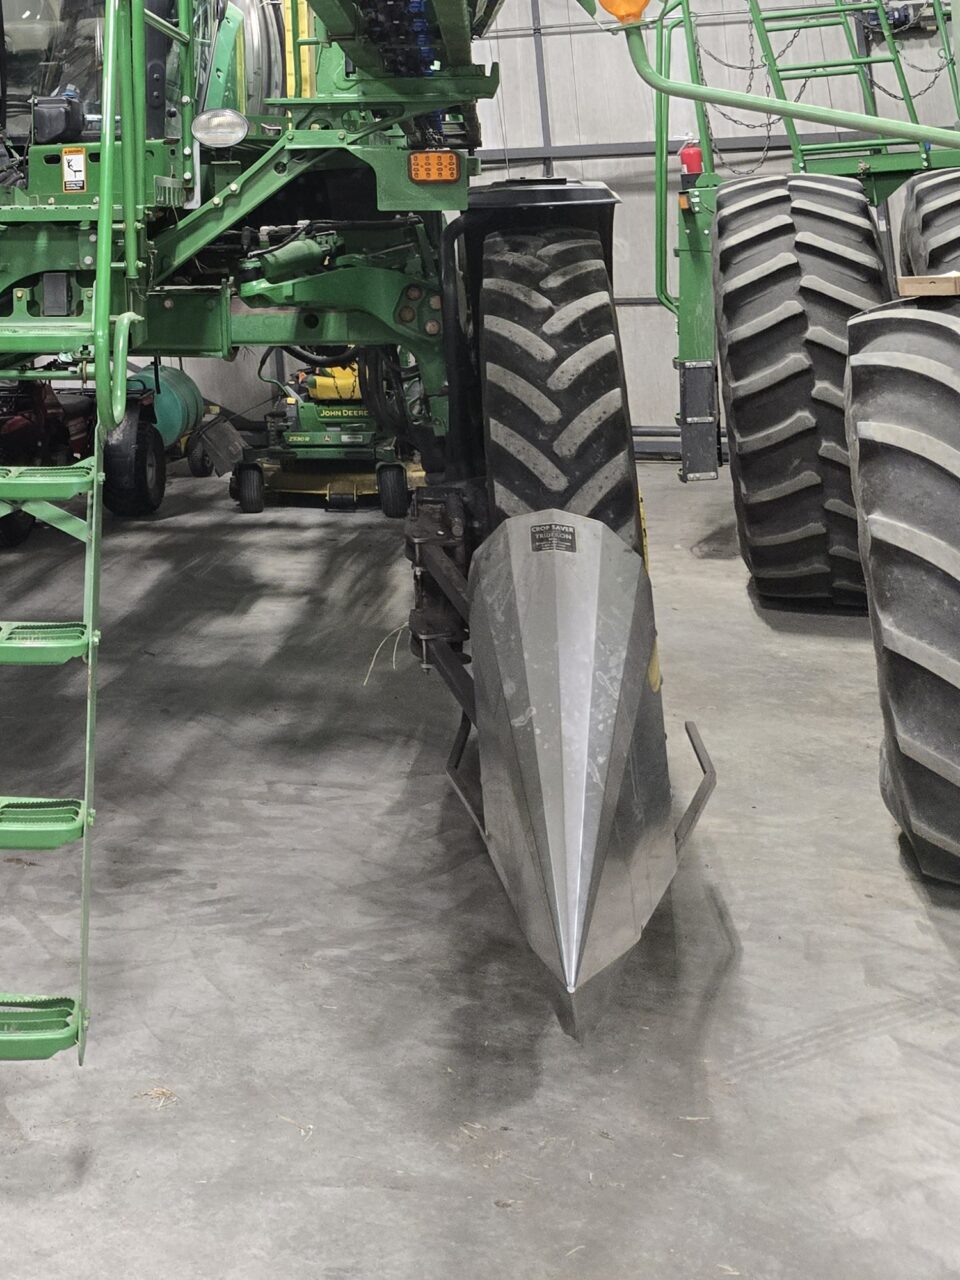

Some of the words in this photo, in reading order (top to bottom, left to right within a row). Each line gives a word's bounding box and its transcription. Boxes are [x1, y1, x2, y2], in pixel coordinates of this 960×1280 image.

[320, 409, 342, 417] JOHN
[531, 525, 550, 533] CROP
[551, 524, 574, 533] SAVER
